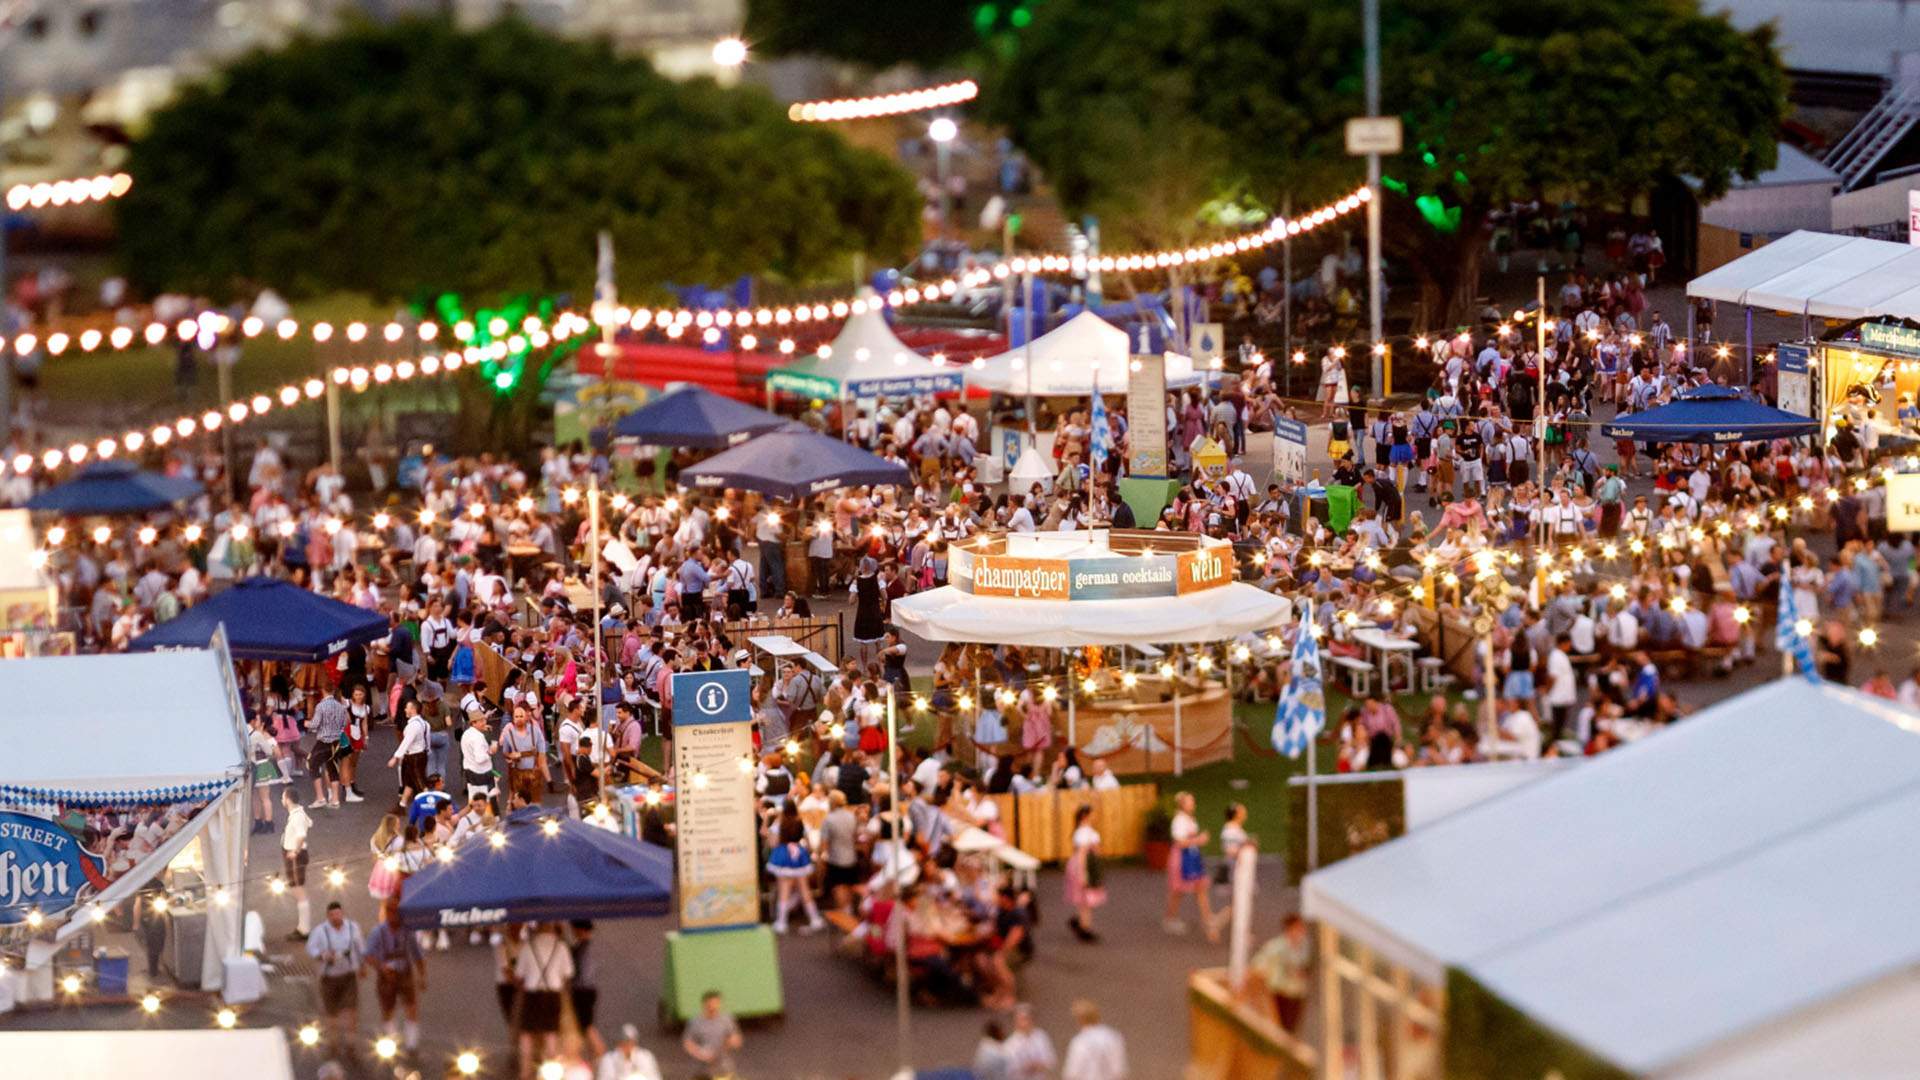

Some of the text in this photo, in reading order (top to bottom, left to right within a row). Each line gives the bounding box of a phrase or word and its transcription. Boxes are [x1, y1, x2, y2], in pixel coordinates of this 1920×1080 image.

[975, 558, 1067, 597] champagner
[1075, 566, 1172, 589] german cocktails
[1190, 557, 1222, 583] wein
[0, 823, 68, 851] STREET
[439, 907, 507, 927] Tucher
